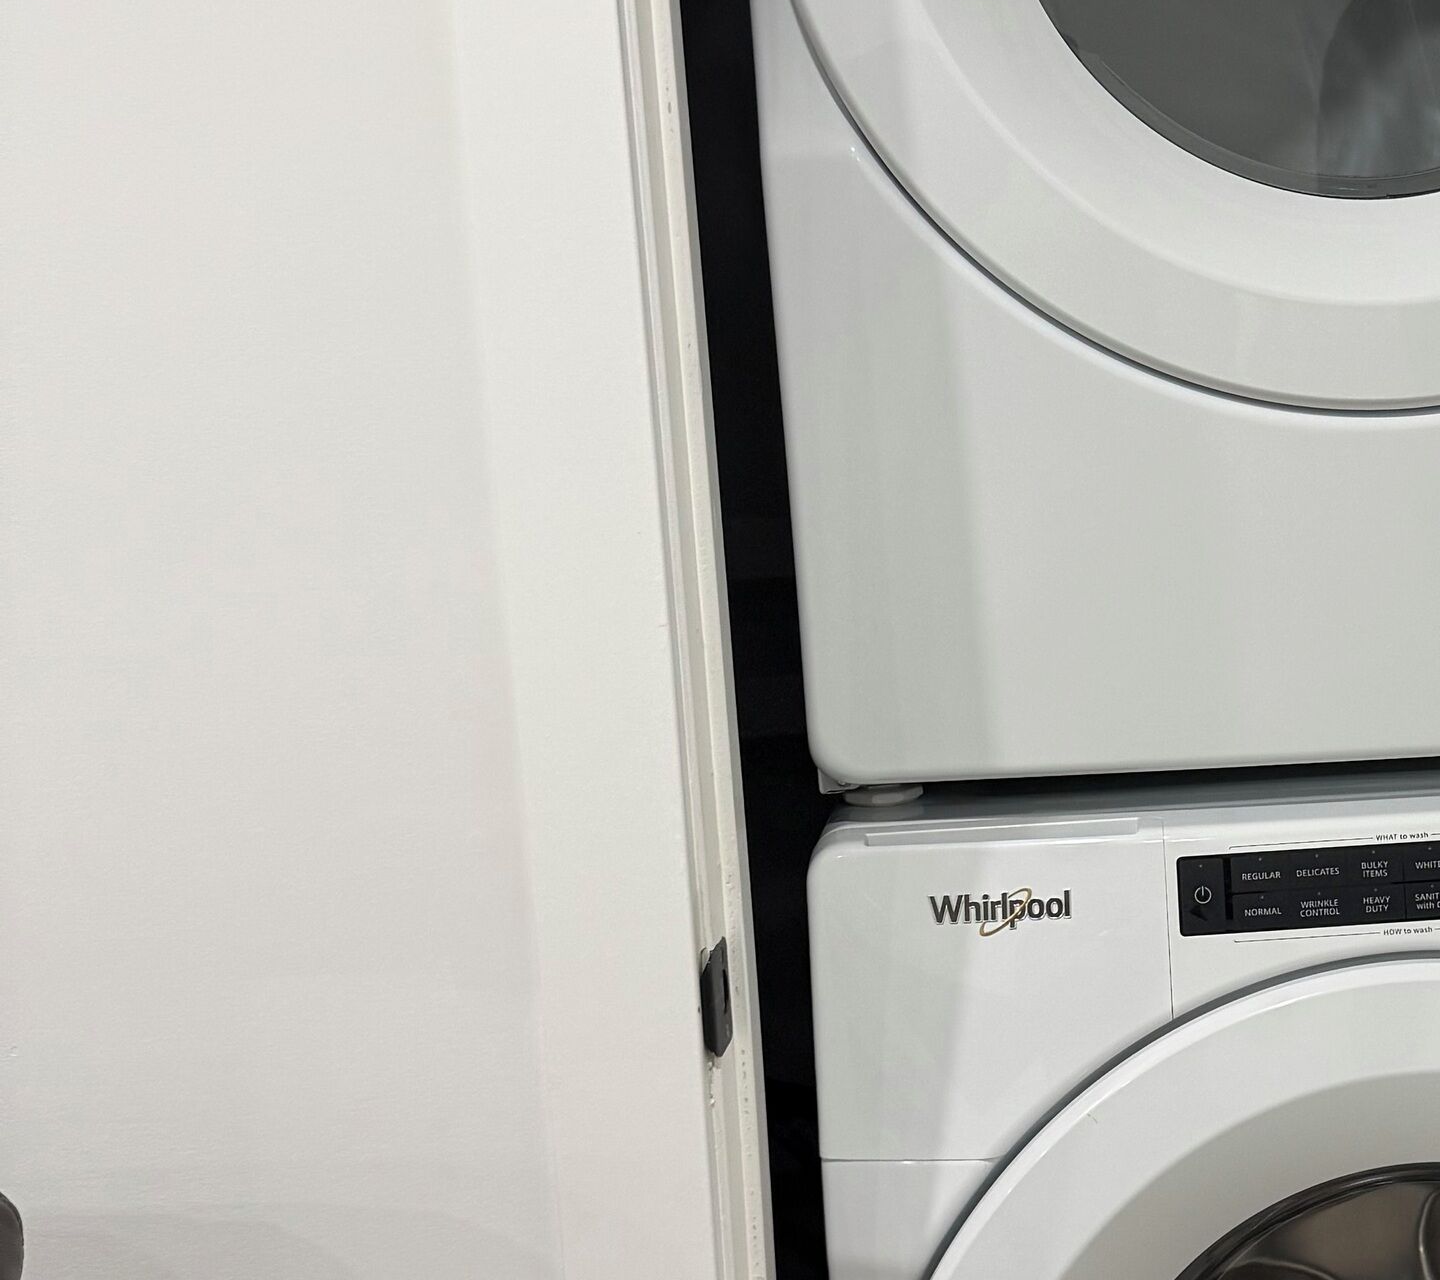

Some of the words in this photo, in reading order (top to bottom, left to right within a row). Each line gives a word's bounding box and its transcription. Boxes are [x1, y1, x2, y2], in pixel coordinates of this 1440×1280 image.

[1375, 833, 1397, 841] WHAT
[1409, 831, 1429, 839] wash
[1361, 860, 1389, 870] BULKY
[1241, 871, 1281, 881] REGULAR
[1296, 867, 1340, 878] DELICATES
[1362, 869, 1388, 878] ITEMS
[1300, 898, 1339, 909] WRINKLE
[1362, 895, 1391, 905] HEAVY
[927, 887, 1072, 933] Whirlpool
[1365, 904, 1389, 913] DUTY
[1416, 901, 1435, 910] with
[1244, 907, 1282, 917] NORMAL
[1299, 907, 1340, 918] CONTROL
[1383, 928, 1402, 936] HOW
[1412, 925, 1433, 934] wash
